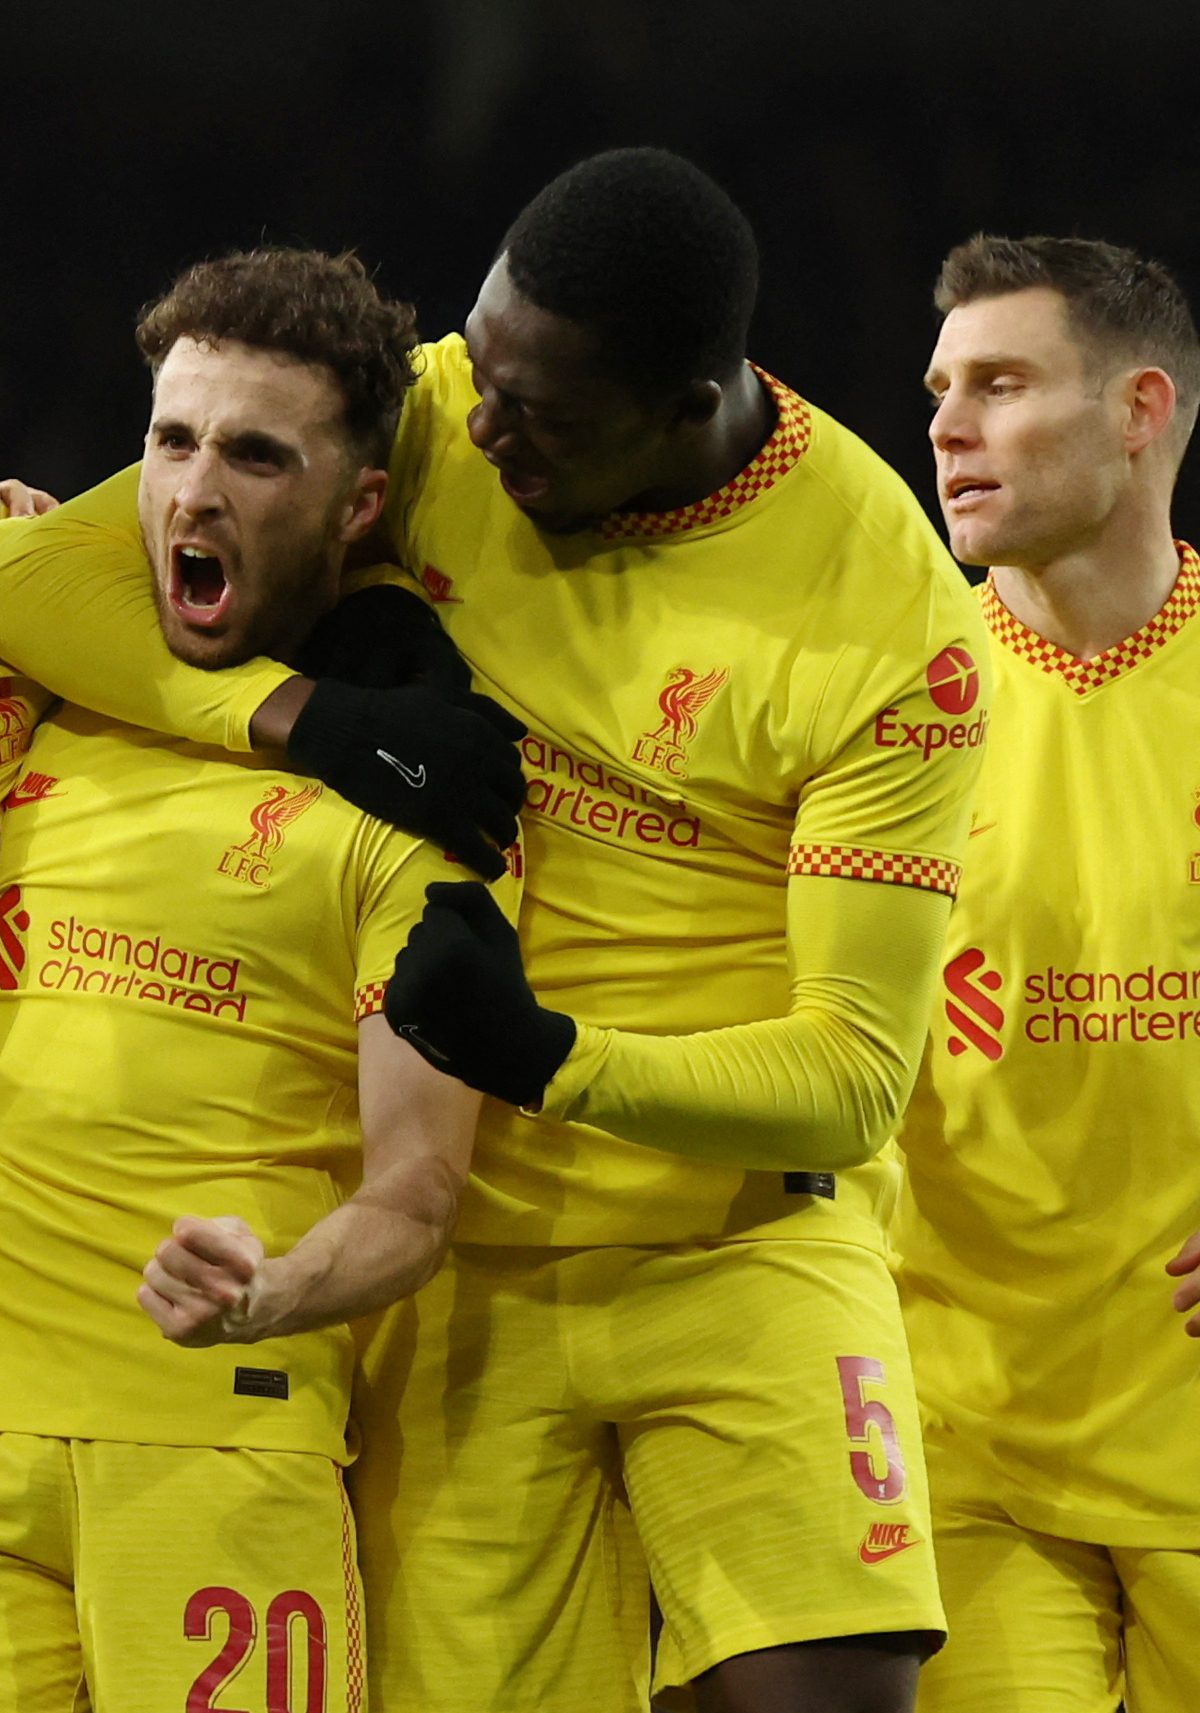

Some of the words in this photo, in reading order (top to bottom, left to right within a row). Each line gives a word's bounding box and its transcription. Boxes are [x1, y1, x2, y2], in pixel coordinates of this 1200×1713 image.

[875, 707, 990, 762] Expedi
[525, 779, 701, 848] artered
[216, 852, 271, 887] L.F.C.
[48, 916, 241, 992] standard
[1024, 965, 1200, 1004] standar
[39, 956, 248, 1023] chartered
[1025, 1006, 1200, 1043] charter
[835, 1356, 907, 1506] 5
[868, 1522, 910, 1547] NIKE
[183, 1586, 328, 1713] 20
